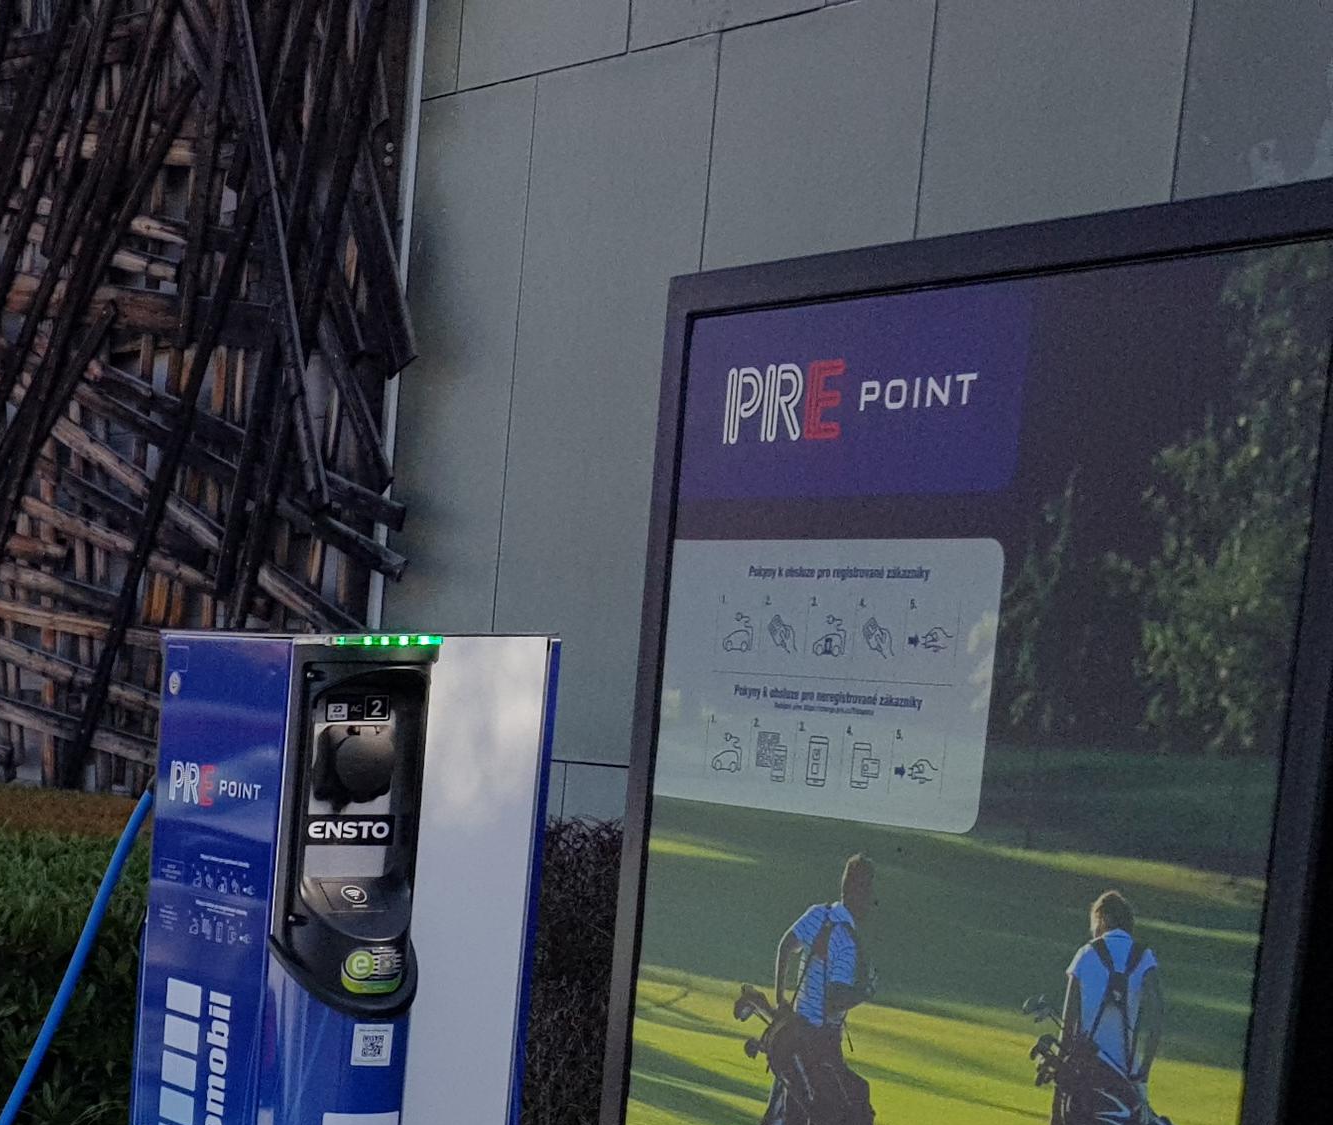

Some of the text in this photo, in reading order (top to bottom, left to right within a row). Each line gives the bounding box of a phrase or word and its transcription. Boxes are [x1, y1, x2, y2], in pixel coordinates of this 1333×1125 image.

[722, 358, 979, 445] PRE POINT
[816, 568, 831, 580] pro
[801, 689, 815, 702] pro
[371, 699, 383, 716] 2
[168, 760, 262, 807] PRE POINT
[308, 821, 390, 839] ENSTO
